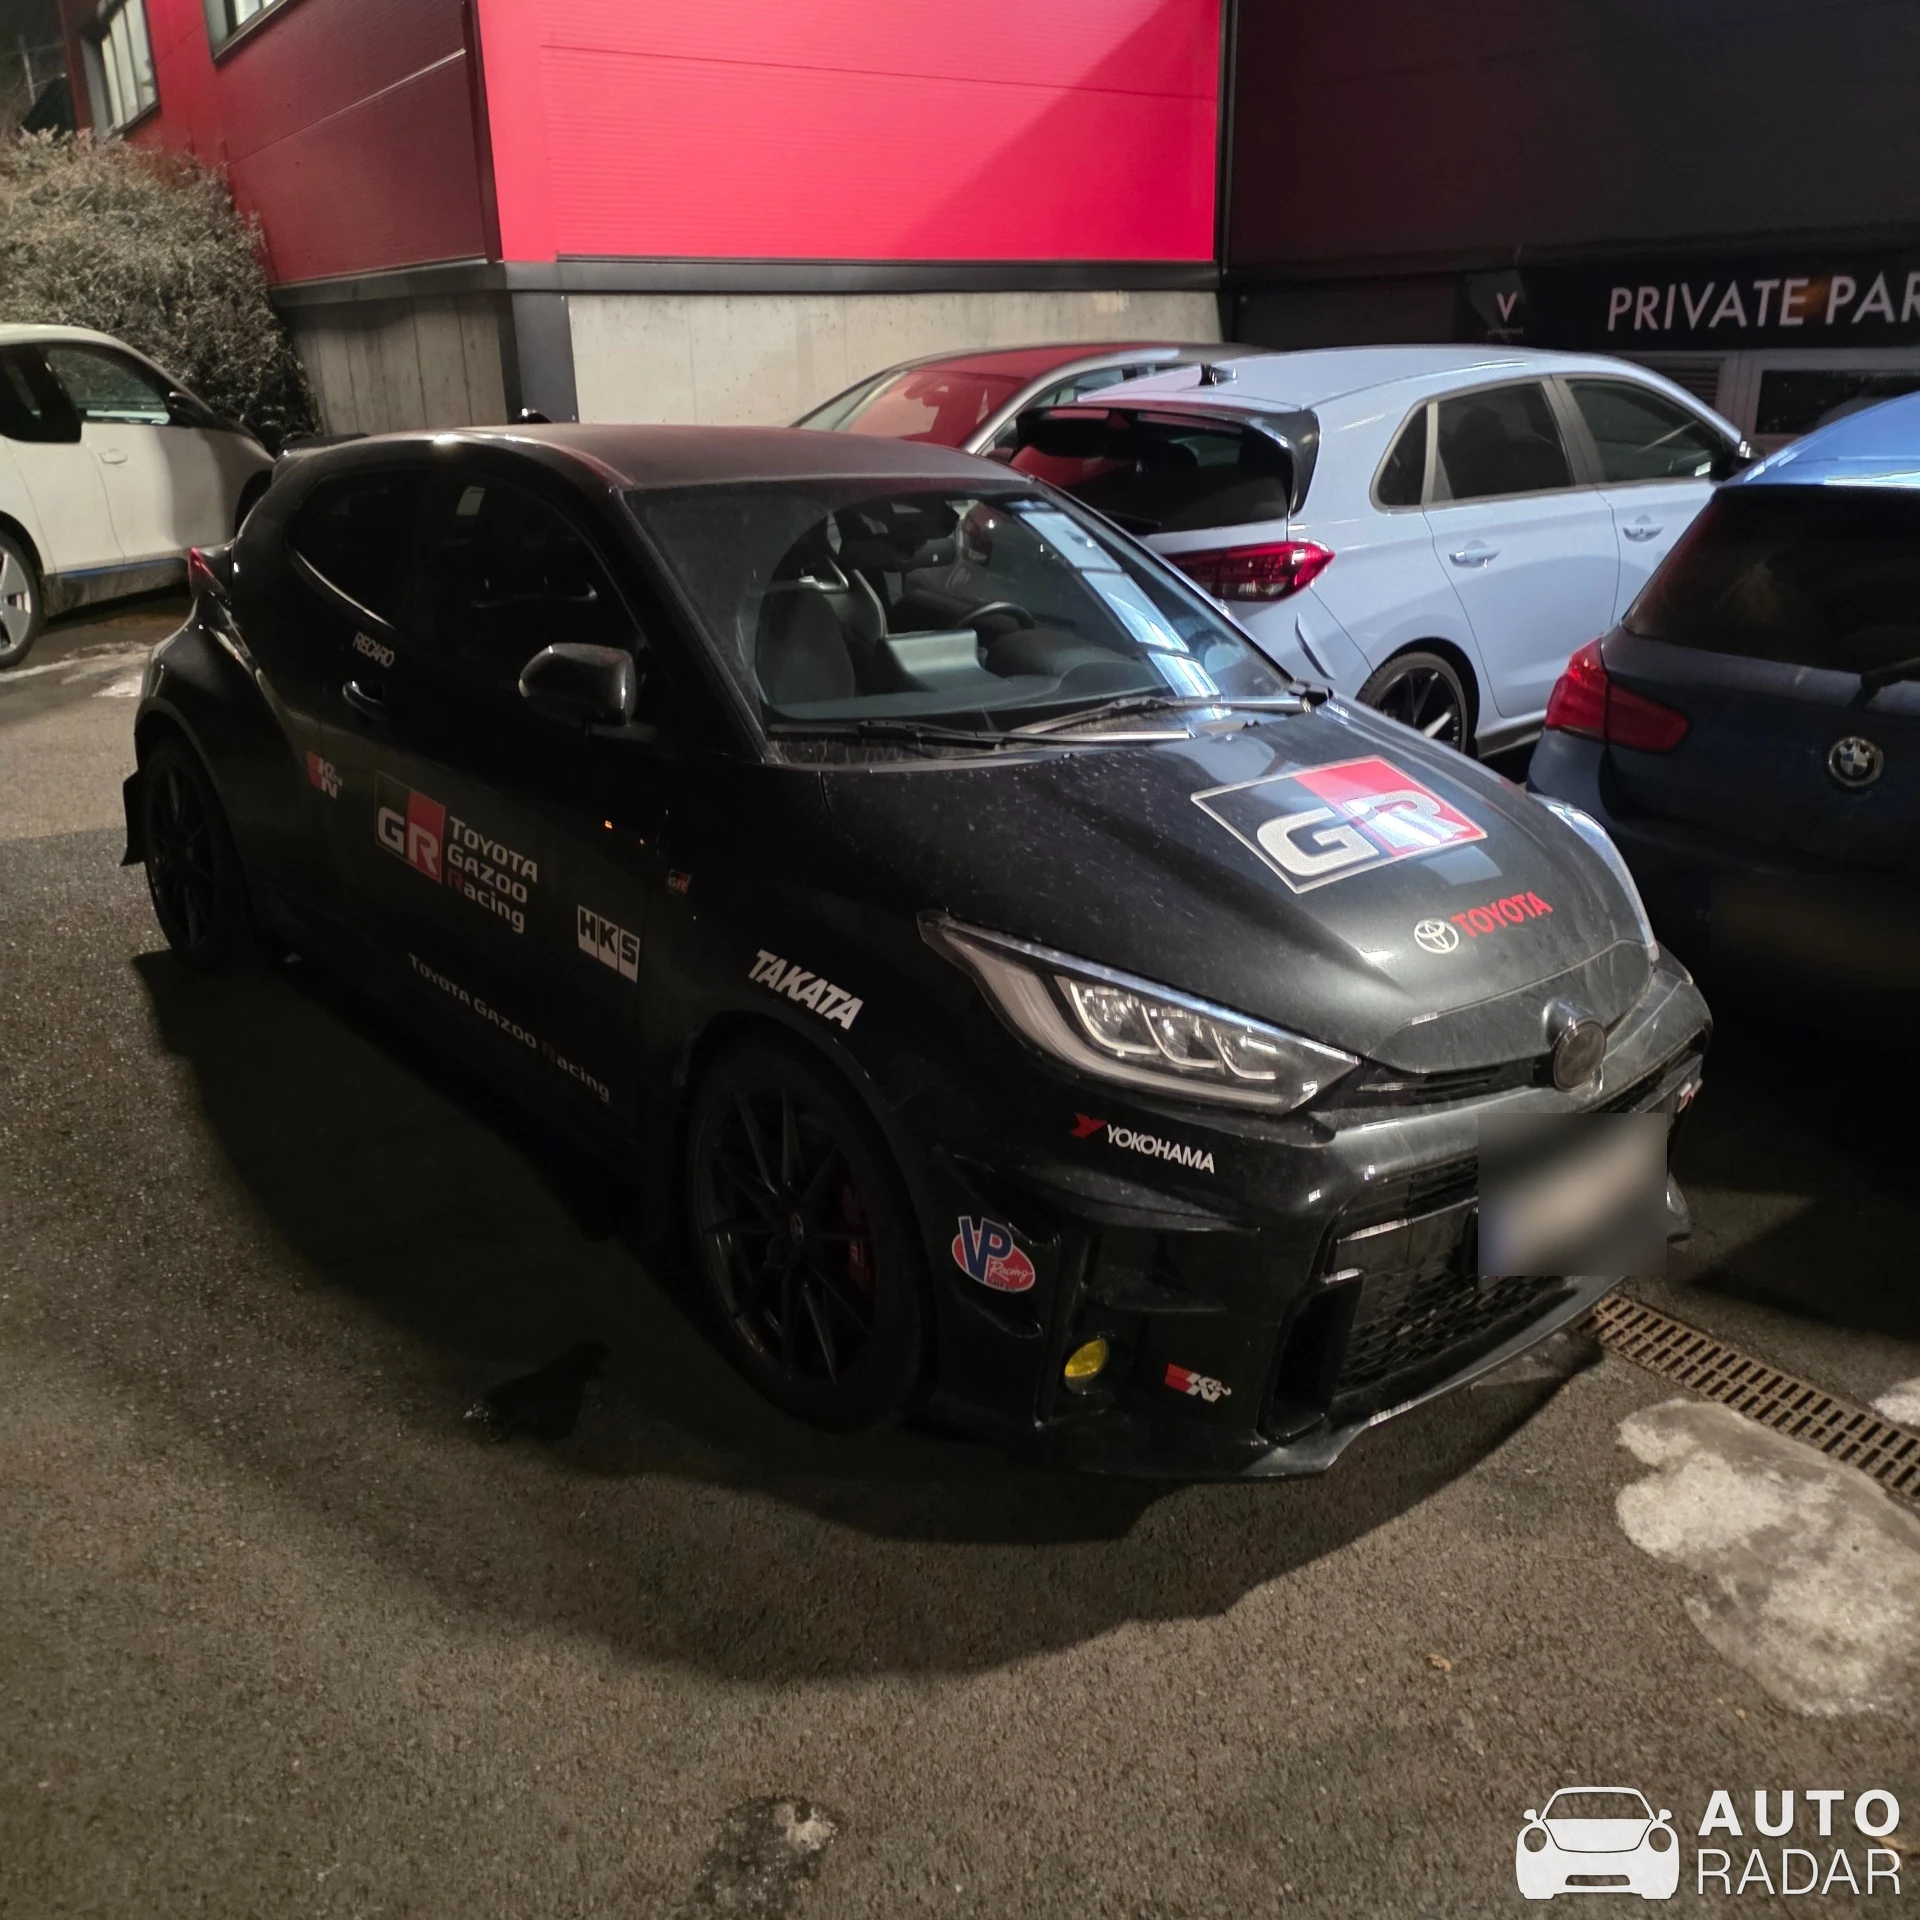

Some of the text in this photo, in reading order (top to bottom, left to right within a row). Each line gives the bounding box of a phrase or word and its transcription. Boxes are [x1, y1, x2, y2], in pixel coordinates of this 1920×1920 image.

[1607, 278, 1810, 332] PRIVATE
[352, 631, 395, 668] RECARO
[377, 806, 439, 877] GR
[449, 815, 538, 883] TOYOTA
[1256, 789, 1470, 867] GR
[447, 843, 528, 904] GAZOO
[447, 867, 525, 935] Racing
[580, 908, 638, 966] HKS
[1450, 891, 1553, 938] TOYOTA
[408, 952, 471, 1006] TOYOTA
[474, 998, 537, 1049] GAZOO
[748, 948, 864, 1030] TAKATA
[1106, 1123, 1215, 1175] YOKOHAMA
[958, 1215, 1014, 1284] VP
